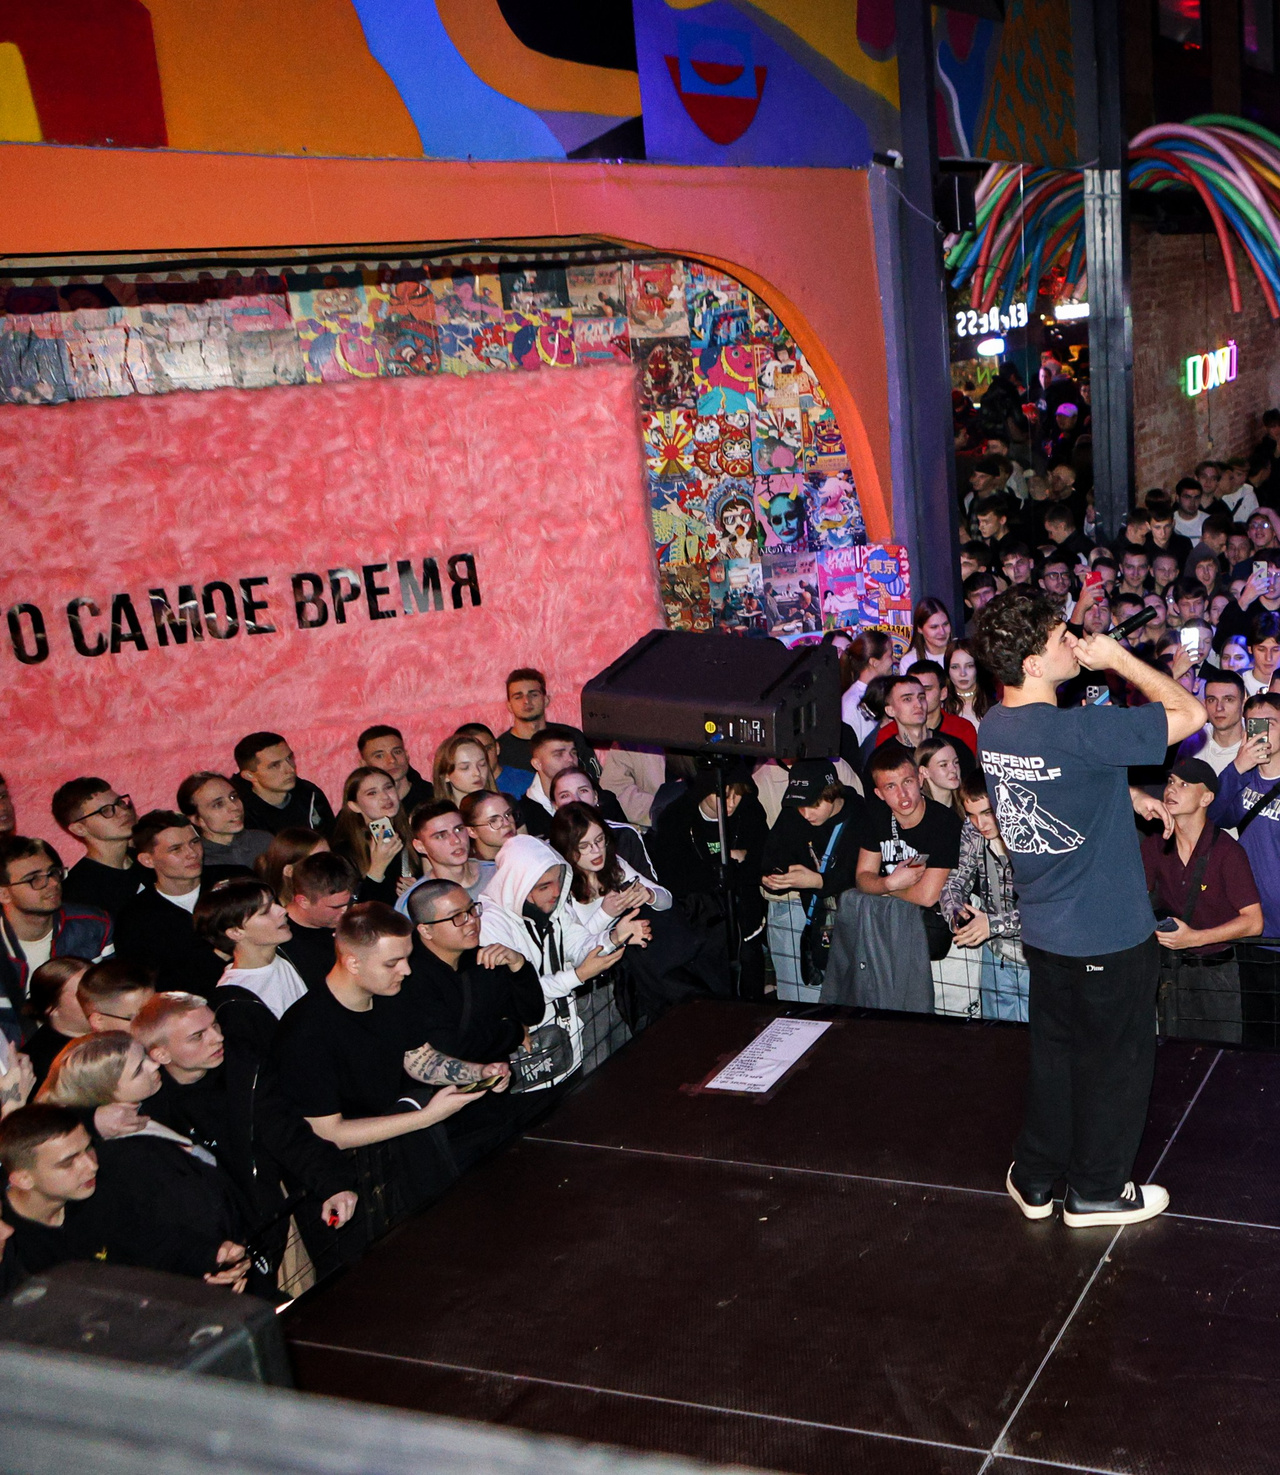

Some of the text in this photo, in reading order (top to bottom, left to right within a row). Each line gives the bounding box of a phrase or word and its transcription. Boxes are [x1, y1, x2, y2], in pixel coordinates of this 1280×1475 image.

[868, 559, 898, 575] 東京
[0, 553, 482, 665] О САМОЕ ВРЕМЯ
[981, 750, 1045, 769] DEFEND
[980, 761, 1062, 782] YOURSELF
